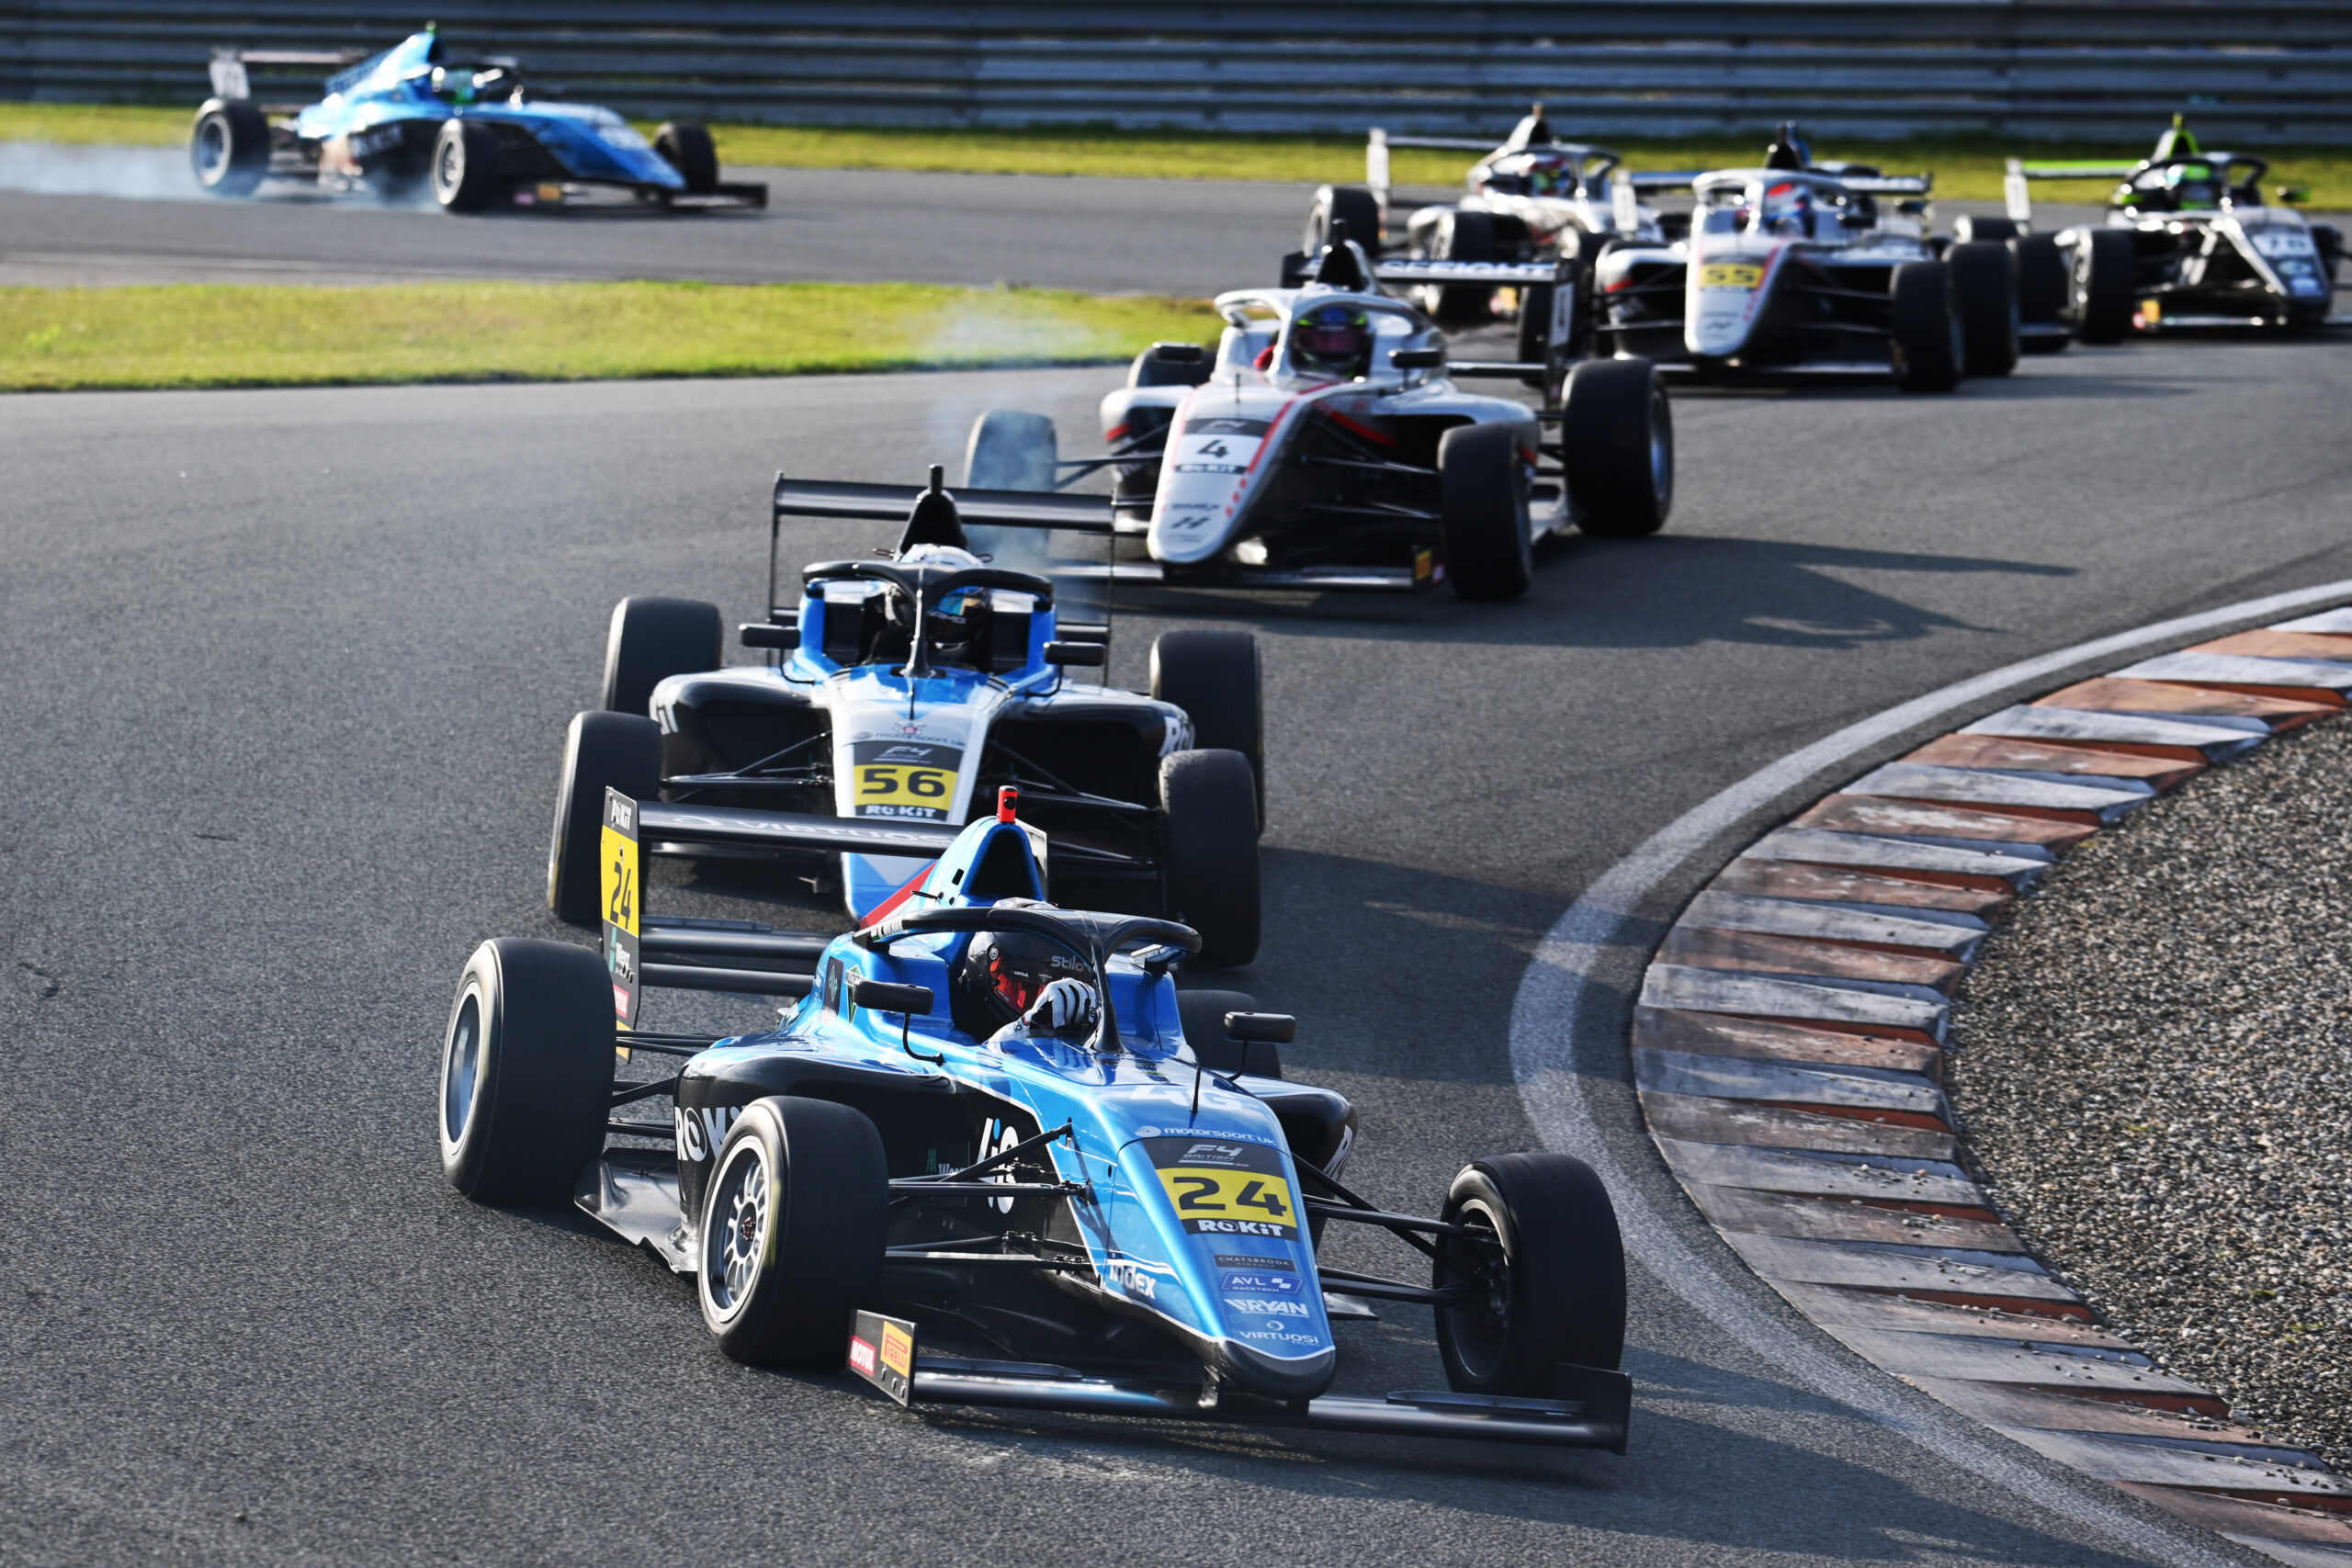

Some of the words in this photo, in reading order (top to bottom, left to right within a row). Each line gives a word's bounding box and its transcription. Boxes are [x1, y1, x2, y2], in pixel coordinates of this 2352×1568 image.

[1196, 439, 1228, 458] 4
[861, 768, 946, 797] 56
[734, 819, 954, 843] VIRTUOS
[609, 860, 631, 930] 24
[1050, 955, 1084, 972] Stilo
[674, 1106, 749, 1162] ROK
[1164, 1127, 1255, 1140] motorsport
[1257, 1135, 1278, 1146] uk
[1187, 1144, 1244, 1156] F4
[1172, 1176, 1288, 1217] 24
[1231, 1277, 1267, 1286] AVL
[1249, 1299, 1308, 1315] RYAN
[1238, 1331, 1319, 1344] VIRTUOSI
[850, 1339, 875, 1372] MOTUL
[884, 1333, 909, 1371] PIRELLI
